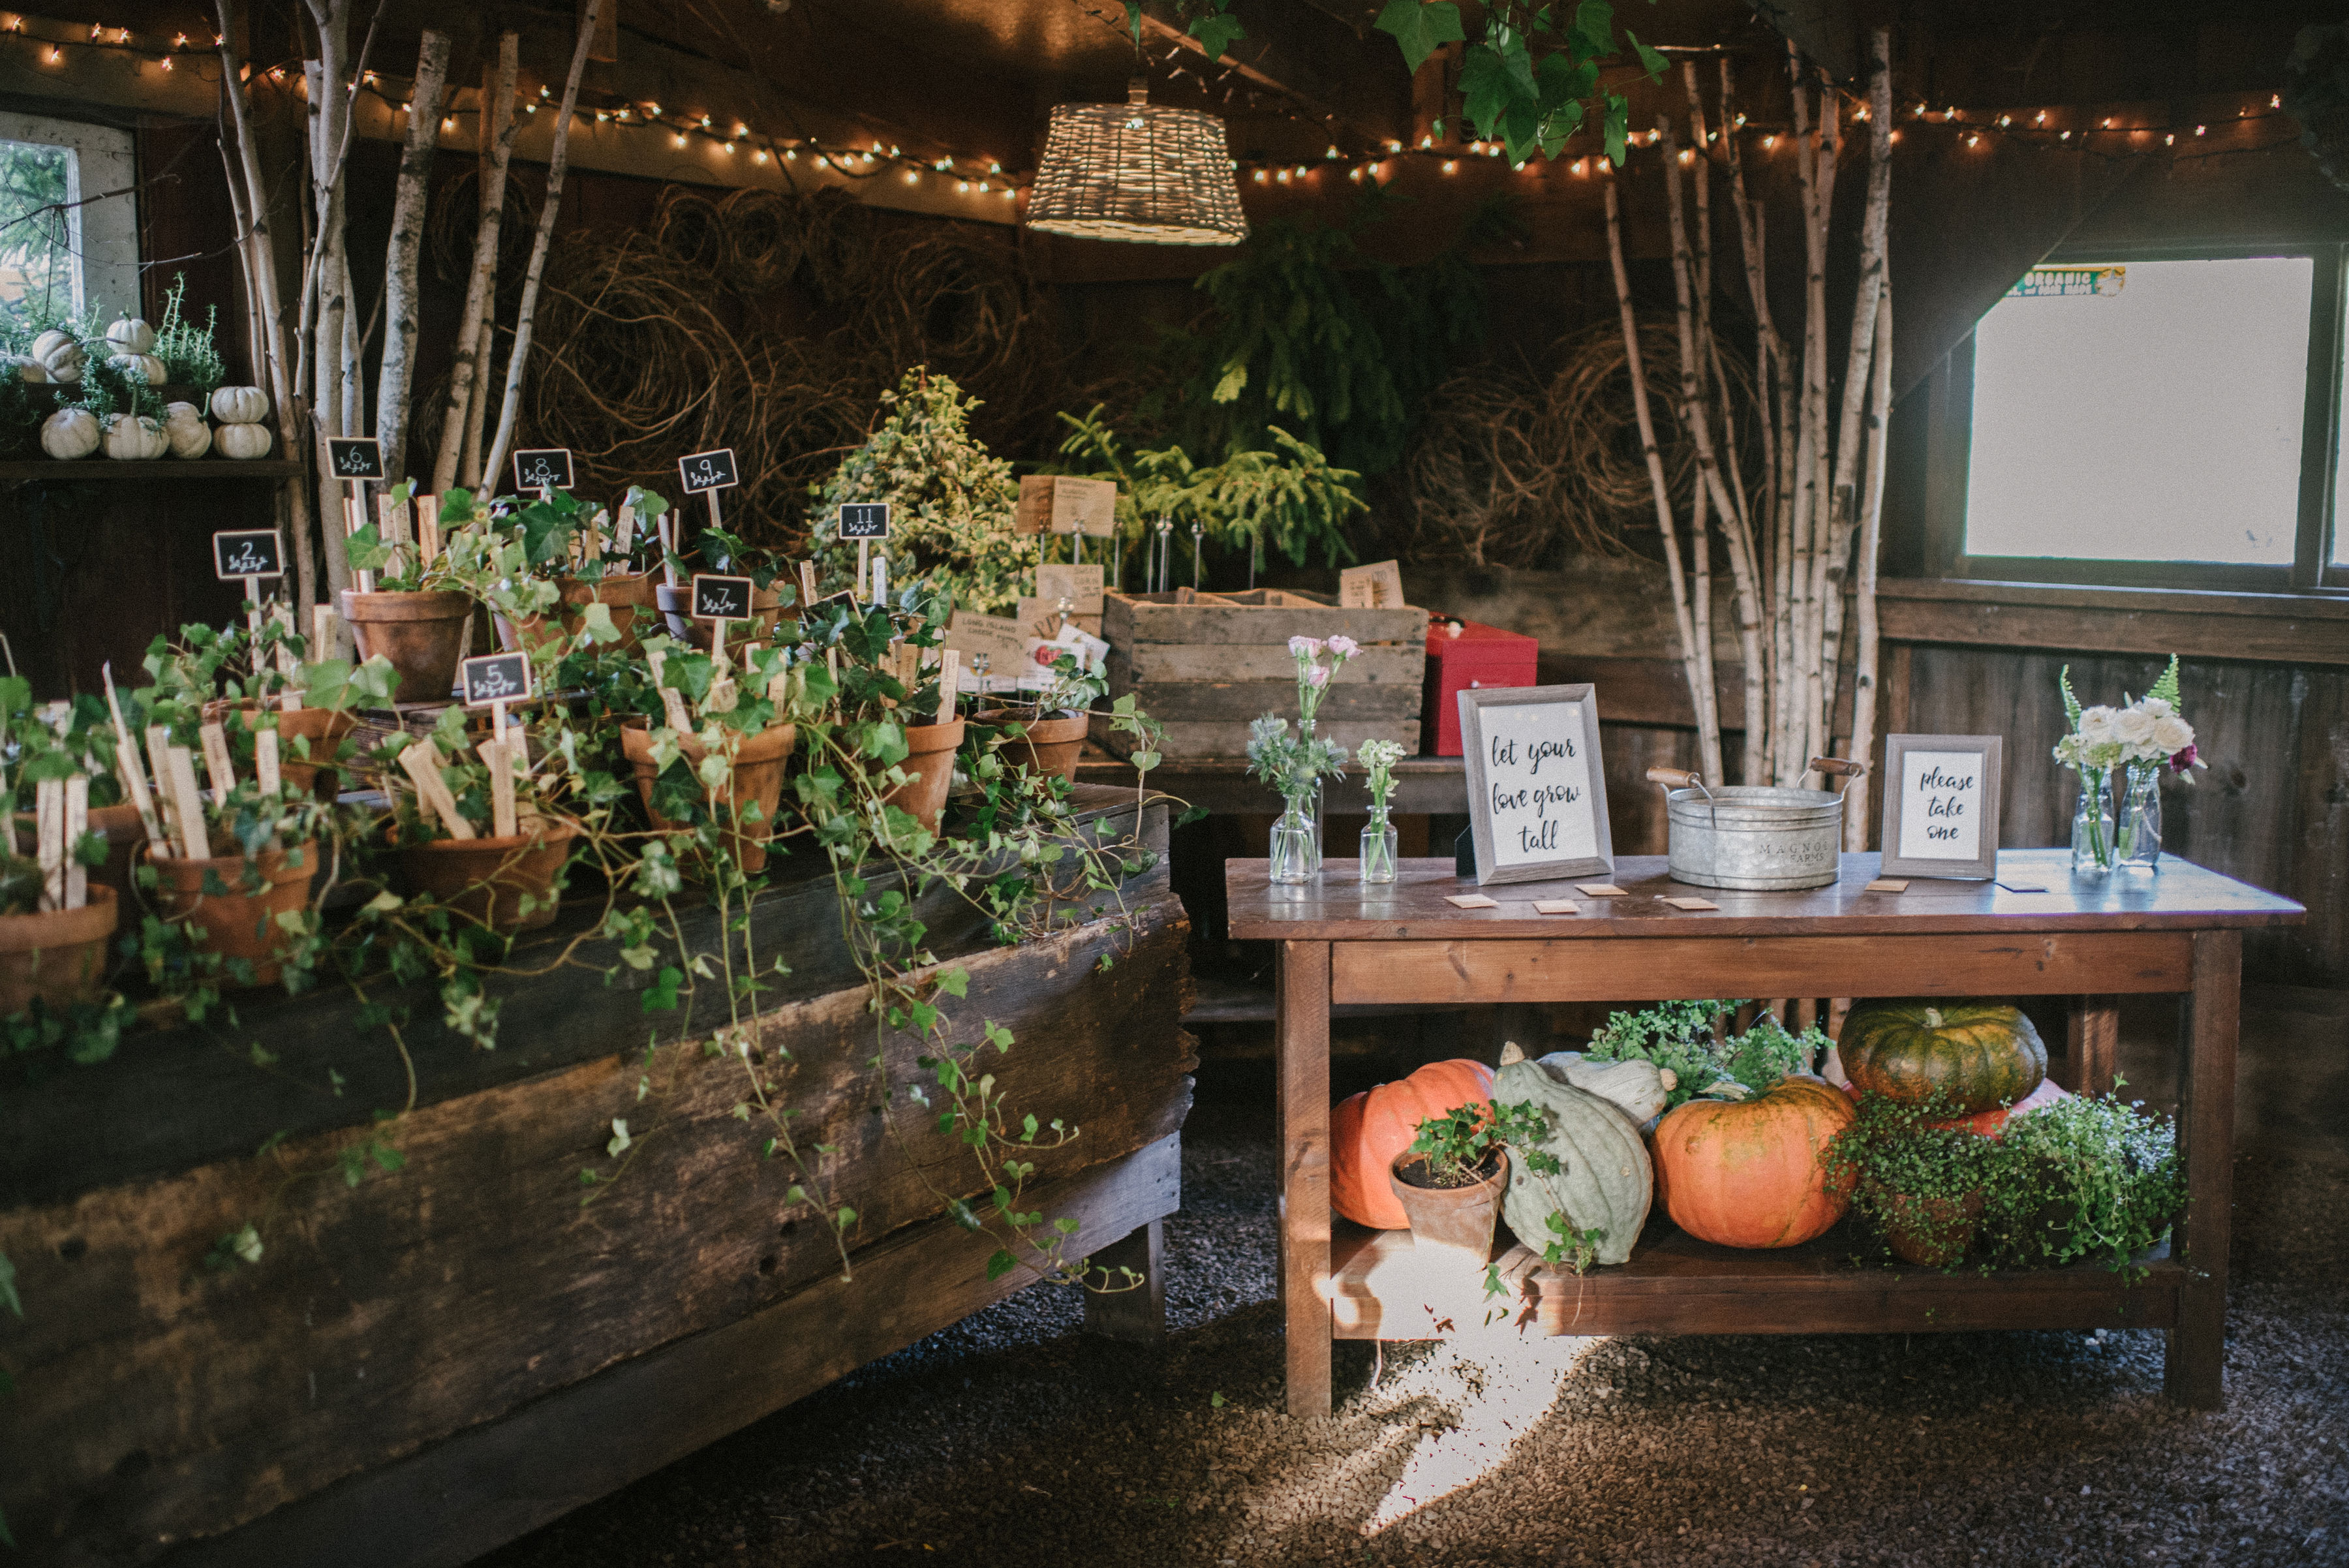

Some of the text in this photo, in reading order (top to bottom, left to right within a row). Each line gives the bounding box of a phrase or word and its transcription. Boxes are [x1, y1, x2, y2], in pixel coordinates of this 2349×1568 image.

[350, 446, 363, 463] 6
[536, 458, 551, 476] 8
[699, 459, 713, 476] 9
[857, 508, 874, 524] 11
[241, 542, 256, 561] 2
[716, 587, 730, 604] 7
[484, 664, 504, 685] 5
[1492, 735, 1576, 775] let your
[1920, 765, 1974, 792] please
[1492, 782, 1582, 818] love grow
[1927, 795, 1965, 818] take
[1517, 820, 1559, 853] tall
[1927, 825, 1959, 840] one
[1758, 840, 1828, 854] MAGNO
[1790, 852, 1824, 863] FARMS
